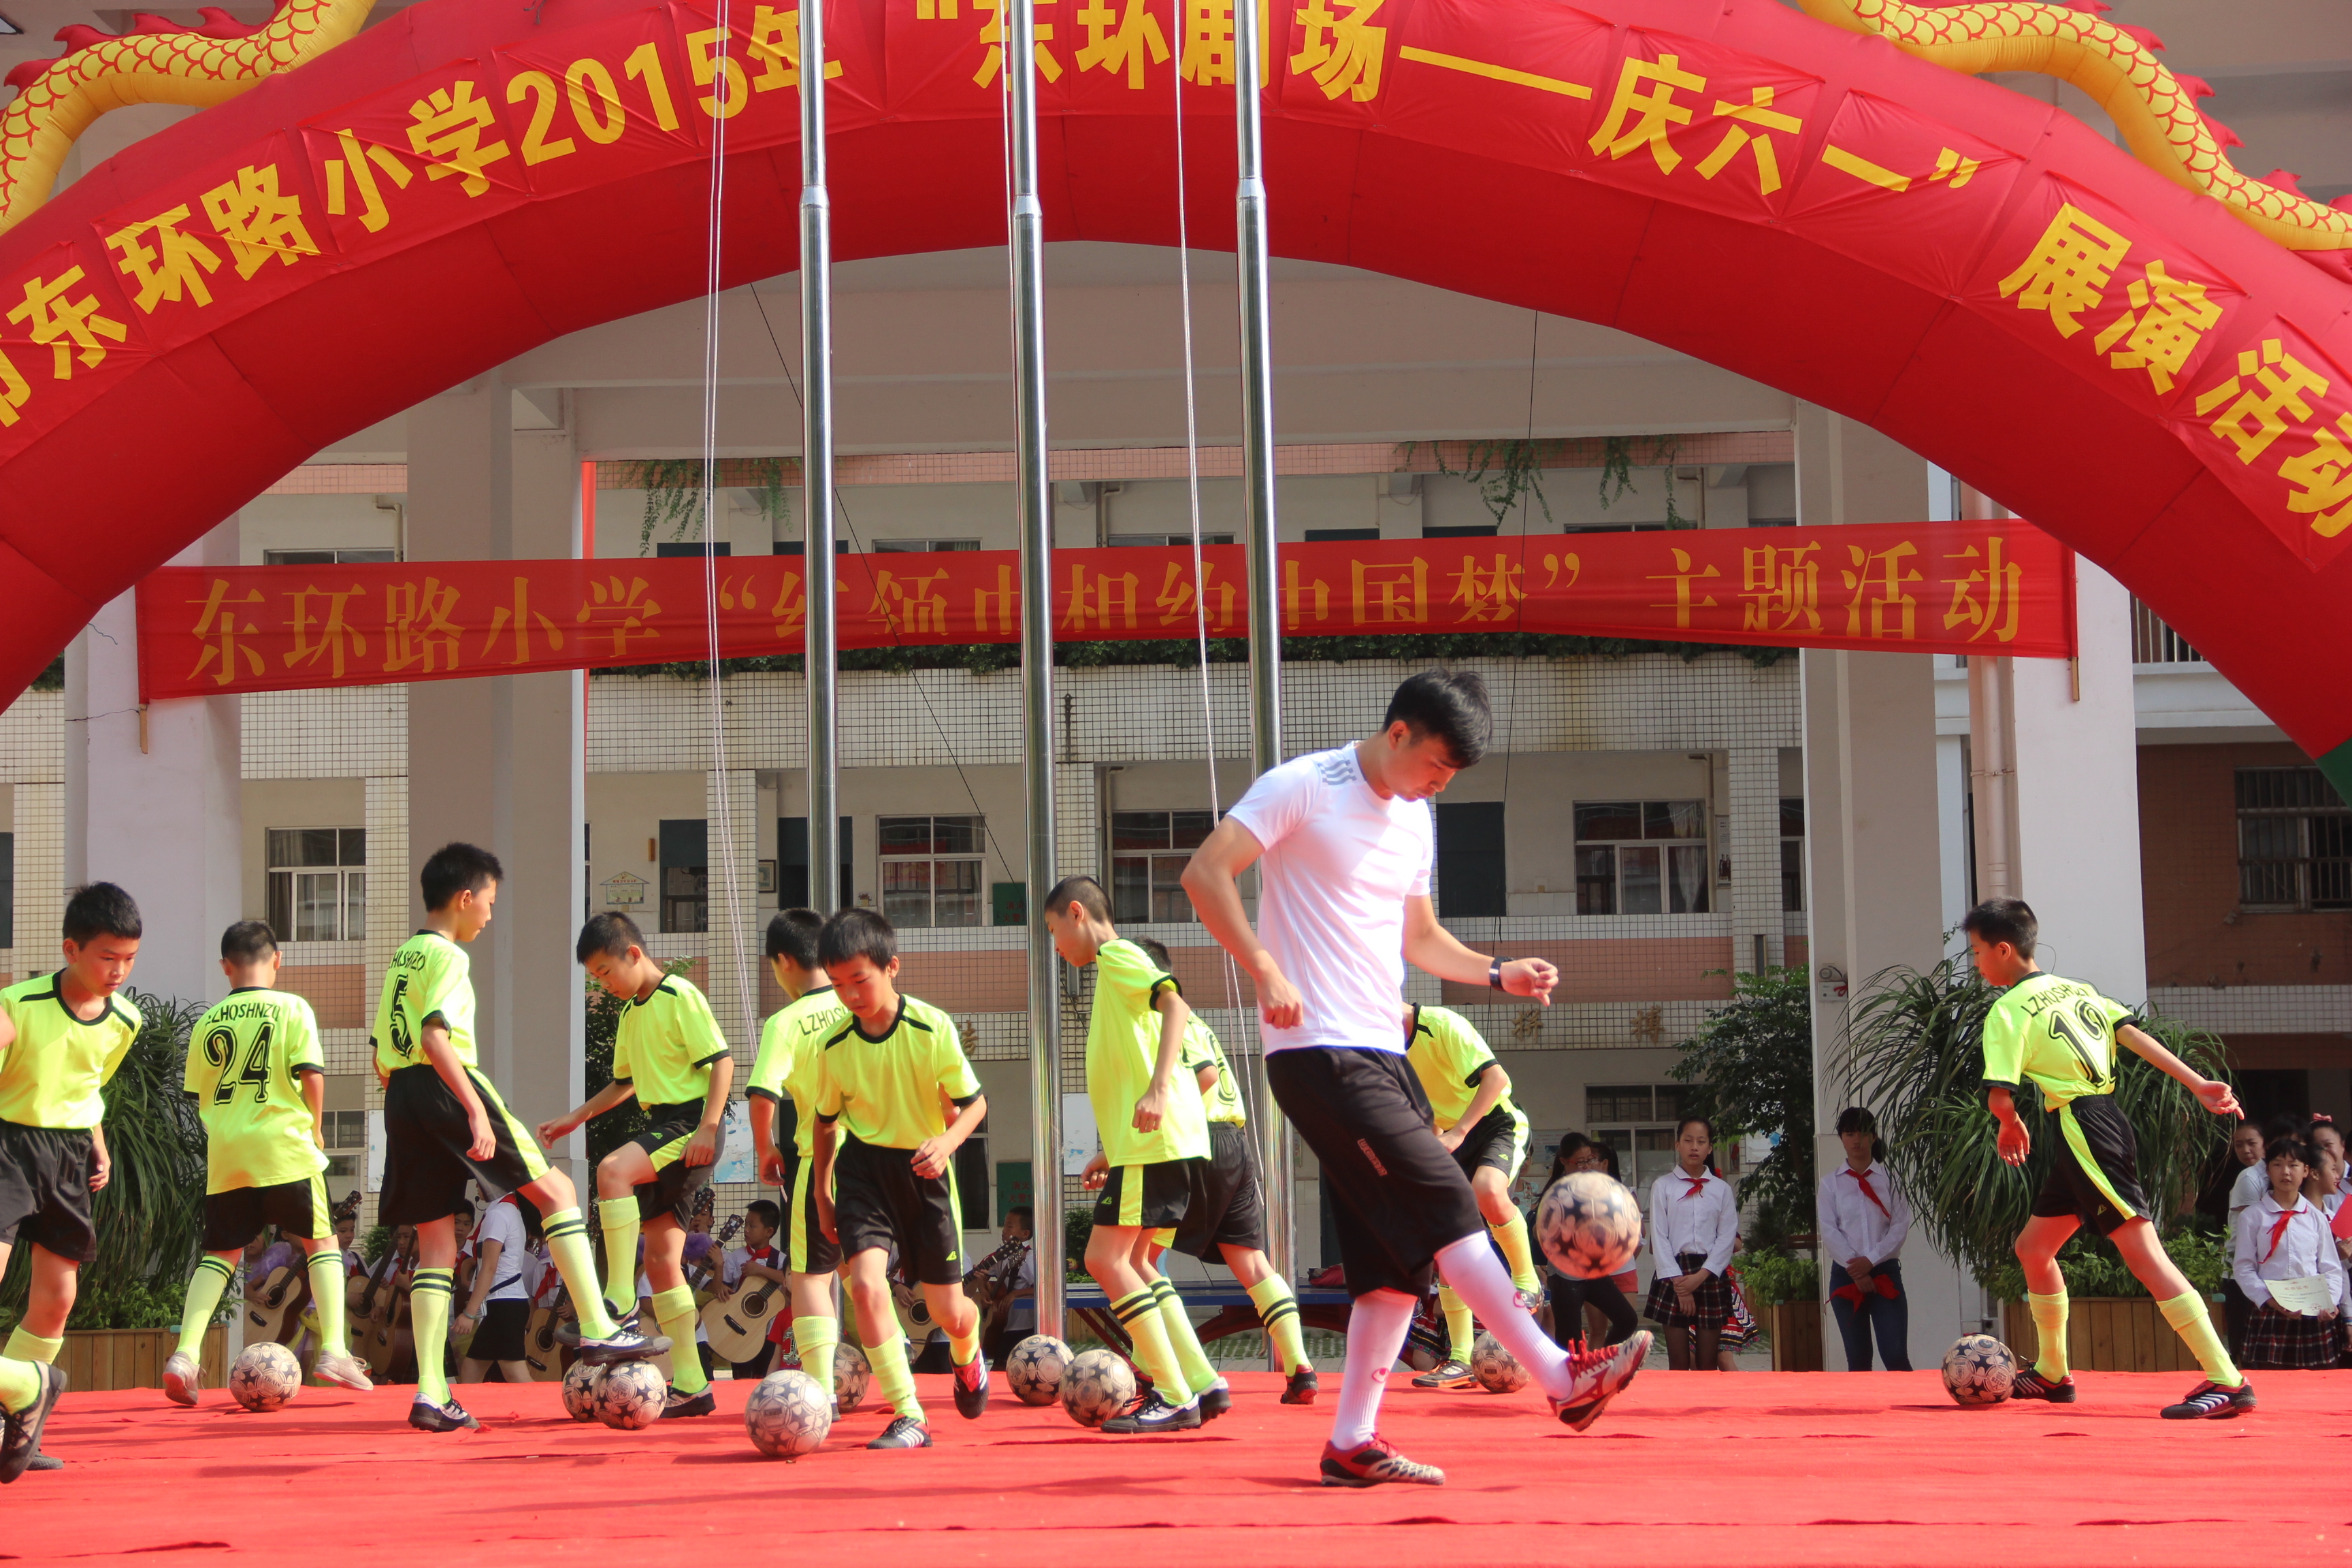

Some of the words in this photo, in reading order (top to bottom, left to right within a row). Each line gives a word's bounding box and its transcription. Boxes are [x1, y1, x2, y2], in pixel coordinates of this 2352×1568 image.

[389, 974, 414, 1059] 5
[2048, 999, 2117, 1088] 19
[203, 1022, 275, 1105] 24
[263, 1375, 282, 1388] TRAIN
